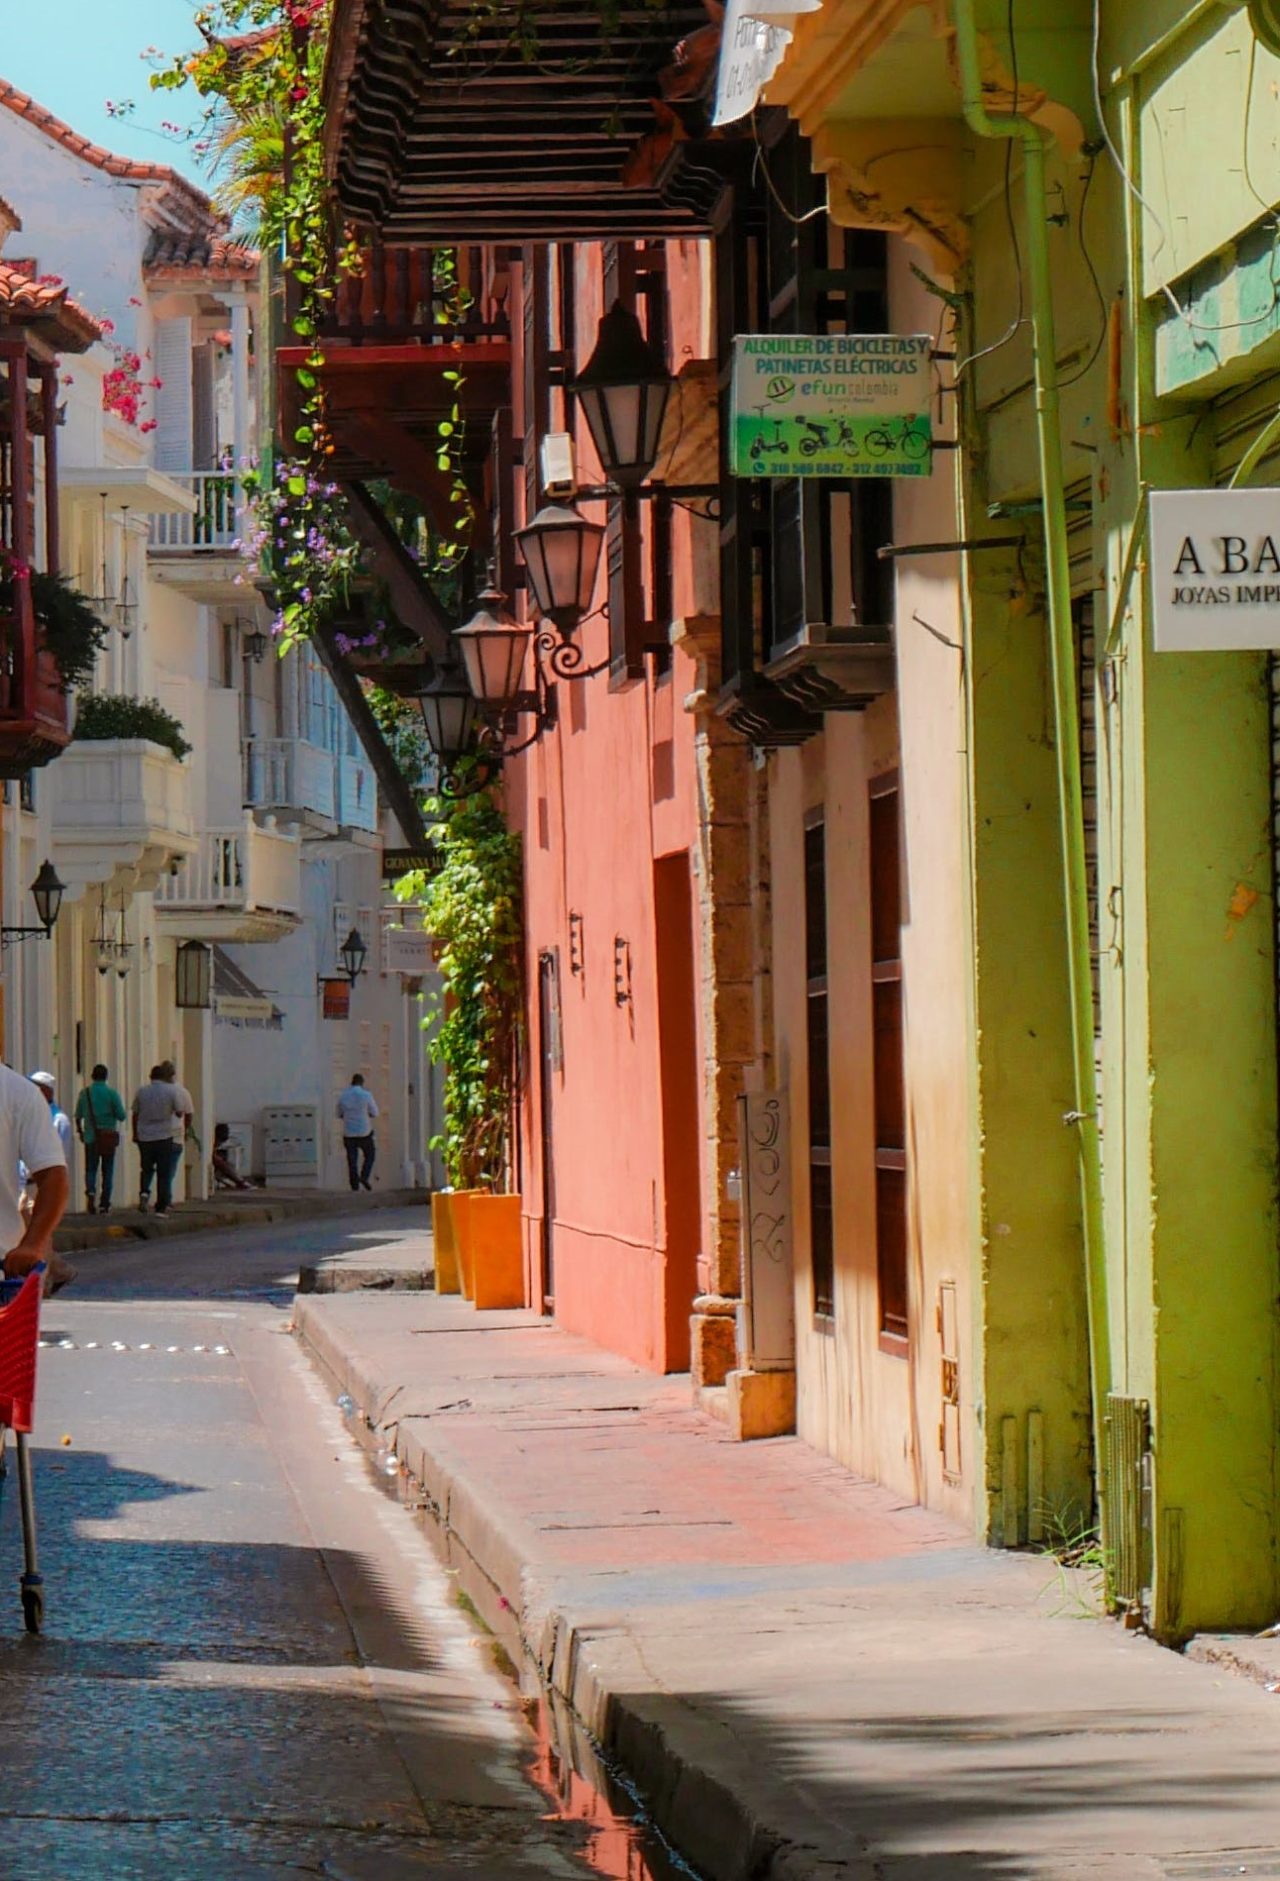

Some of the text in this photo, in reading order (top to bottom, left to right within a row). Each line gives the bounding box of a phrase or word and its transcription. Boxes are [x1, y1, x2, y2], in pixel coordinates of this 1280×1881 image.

[744, 338, 927, 354] ALQUILER DE BICICLETAS Y
[756, 357, 918, 374] PATINETAS ELÉCTRICAS
[1171, 586, 1230, 605] JOYAS
